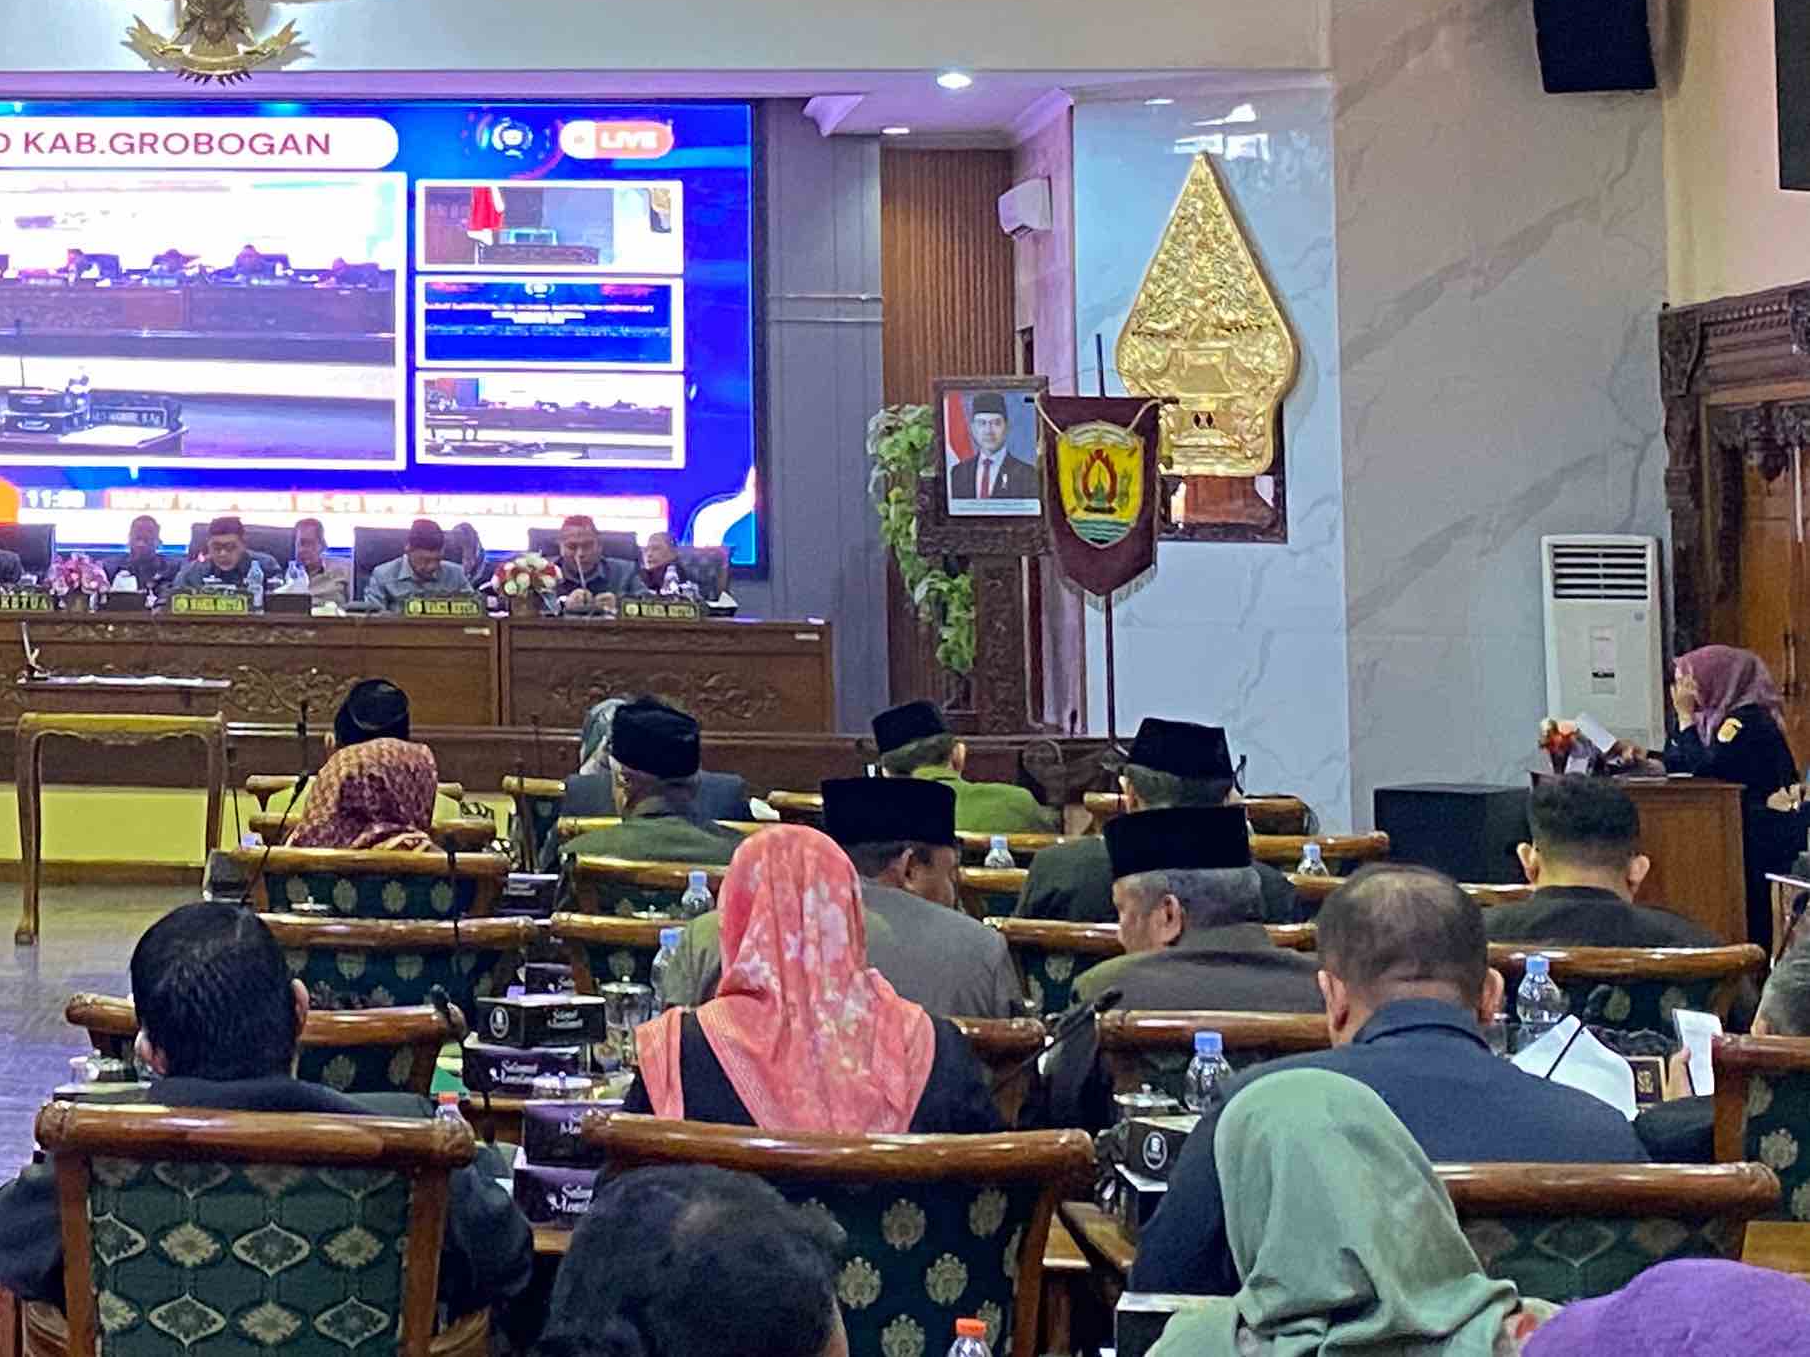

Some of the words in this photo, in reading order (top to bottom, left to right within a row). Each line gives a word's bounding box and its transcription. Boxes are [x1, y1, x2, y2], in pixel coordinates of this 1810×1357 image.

[23, 131, 332, 155] KAB.GROBOGAN
[600, 130, 658, 149] LIVE
[0, 594, 48, 611] KETUA
